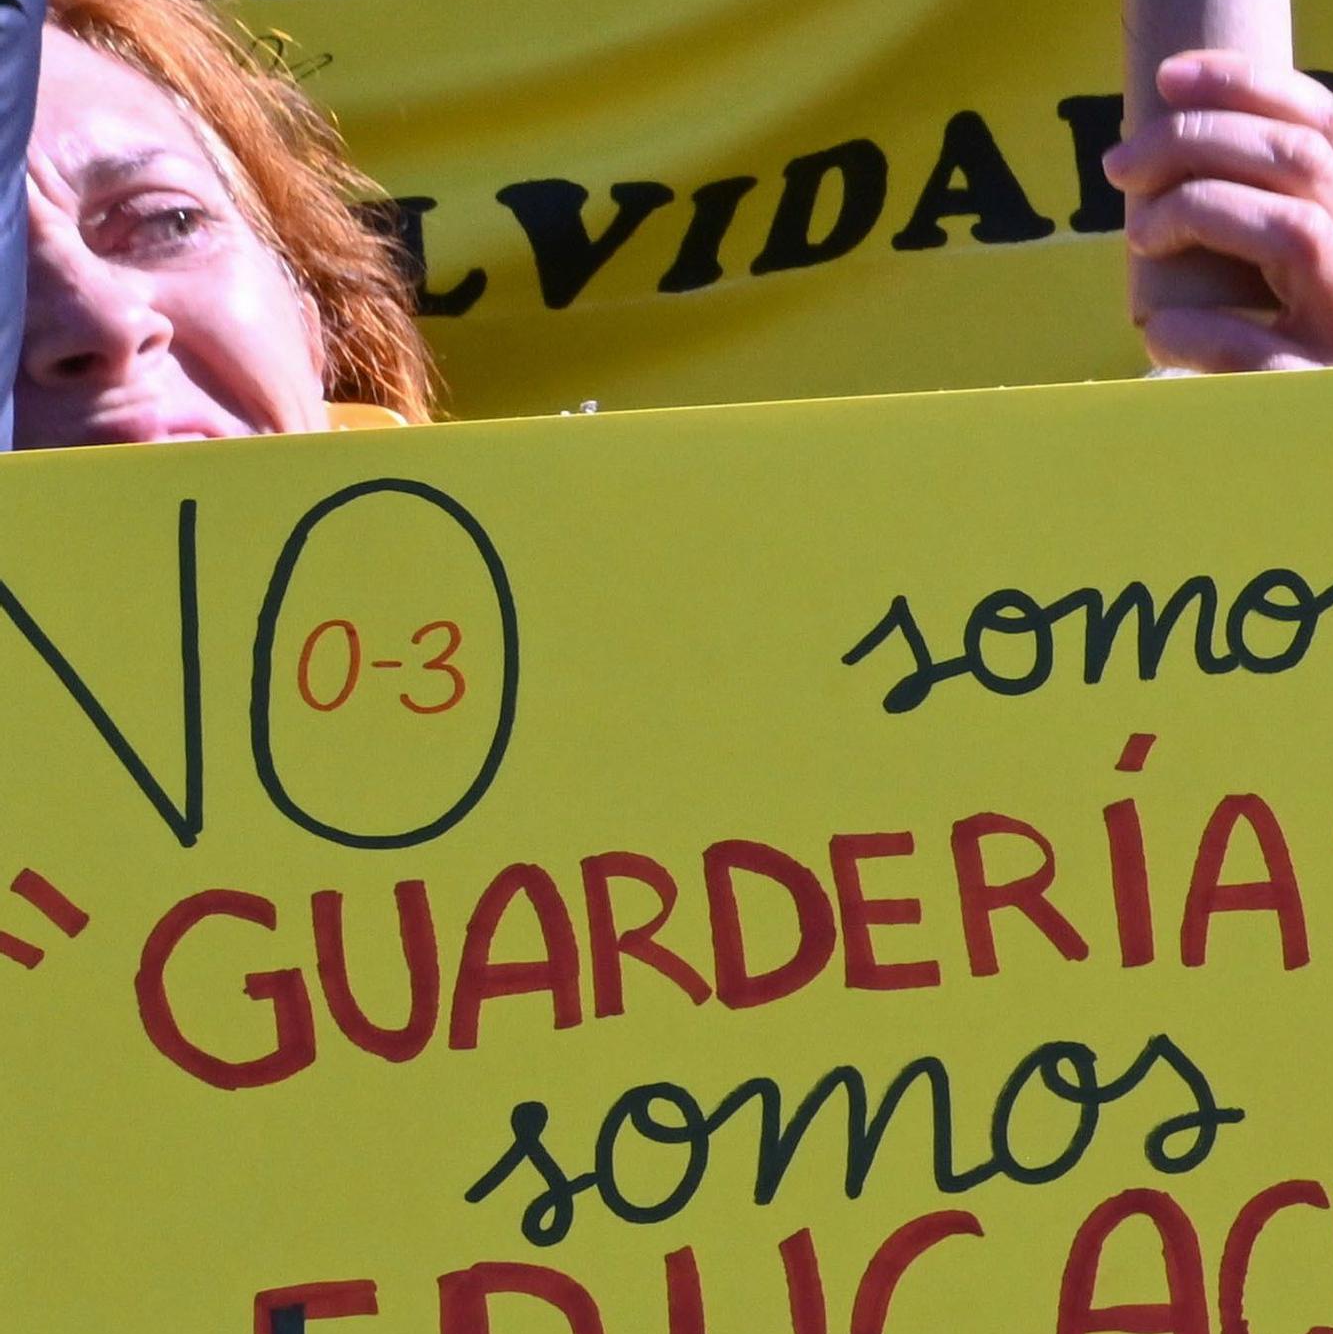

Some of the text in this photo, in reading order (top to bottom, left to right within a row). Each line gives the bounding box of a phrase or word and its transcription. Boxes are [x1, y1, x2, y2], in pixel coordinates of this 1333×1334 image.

[0, 478, 519, 850] NO
[297, 619, 467, 715] 0-3
[464, 1033, 1246, 1247] somos
